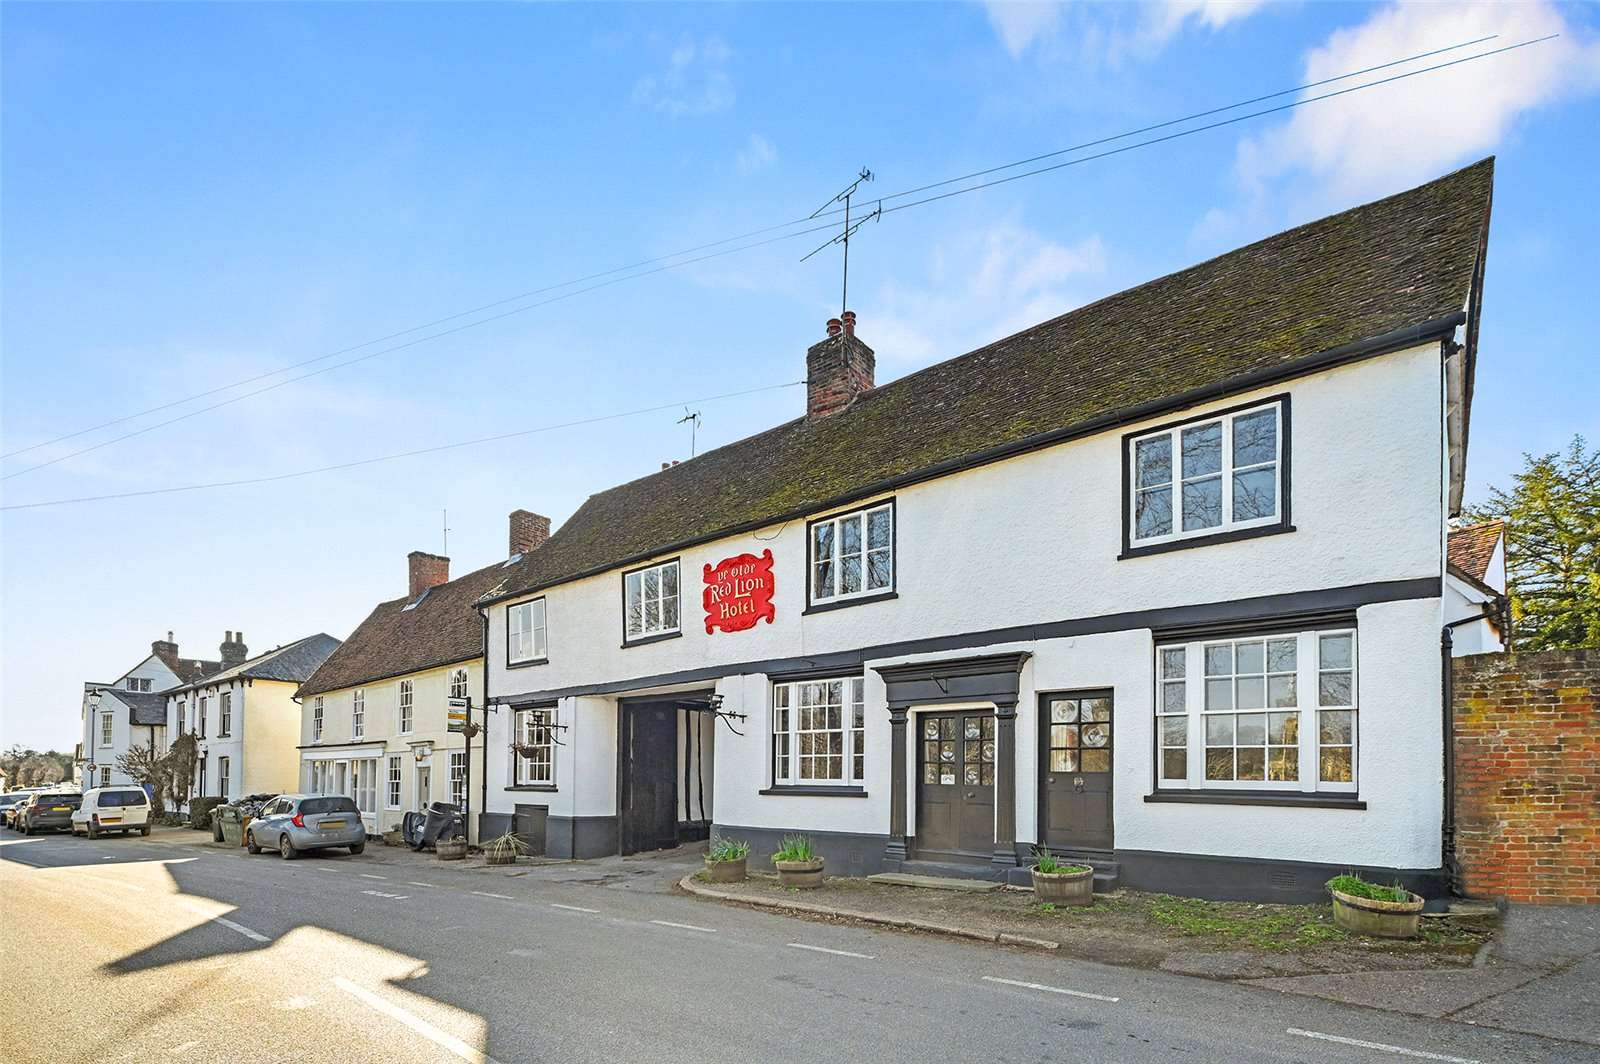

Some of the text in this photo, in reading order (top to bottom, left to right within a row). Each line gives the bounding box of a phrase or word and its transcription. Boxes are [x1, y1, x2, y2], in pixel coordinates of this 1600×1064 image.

[710, 577, 764, 604] Red Lion
[720, 599, 755, 619] Hotel
